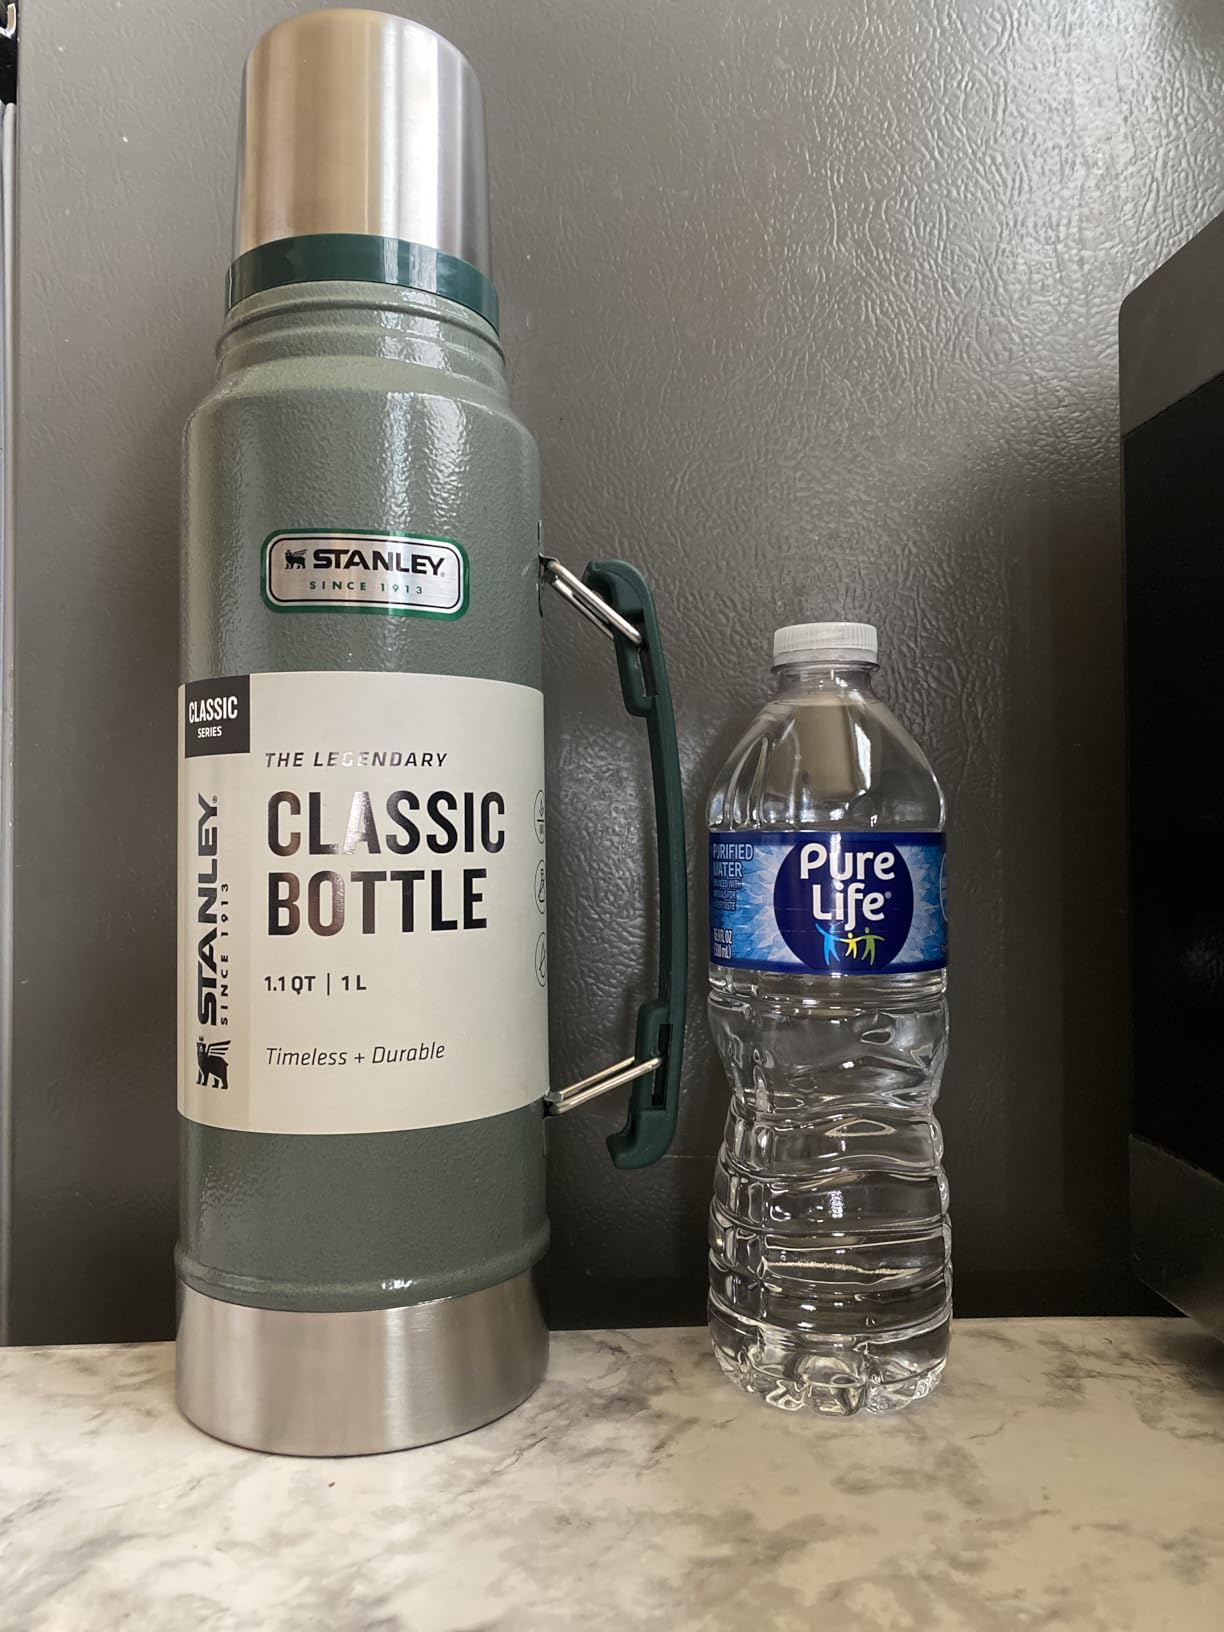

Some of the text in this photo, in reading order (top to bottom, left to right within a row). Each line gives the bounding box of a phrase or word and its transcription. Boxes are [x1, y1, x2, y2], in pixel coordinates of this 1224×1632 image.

[313, 548, 445, 576] STANLEY
[309, 581, 423, 594] SINCE 1913
[188, 696, 238, 724] CLASSIC
[197, 726, 223, 738] SERIES
[265, 752, 447, 768] THE LEGENDARY
[268, 790, 505, 857] CLASSIC
[712, 843, 753, 860] PURIFIED
[800, 842, 895, 881] Pure
[713, 861, 743, 878] WATER
[197, 792, 218, 1026] STANLEY
[268, 868, 488, 937] BOTTLE
[812, 882, 886, 932] Life
[220, 883, 229, 1025] SINCE 1913
[264, 975, 286, 992] 1.1
[291, 975, 316, 995] QT
[341, 975, 350, 991] 1
[356, 974, 367, 991] L
[266, 1047, 348, 1066] Timeless
[371, 1041, 445, 1064] Durable
